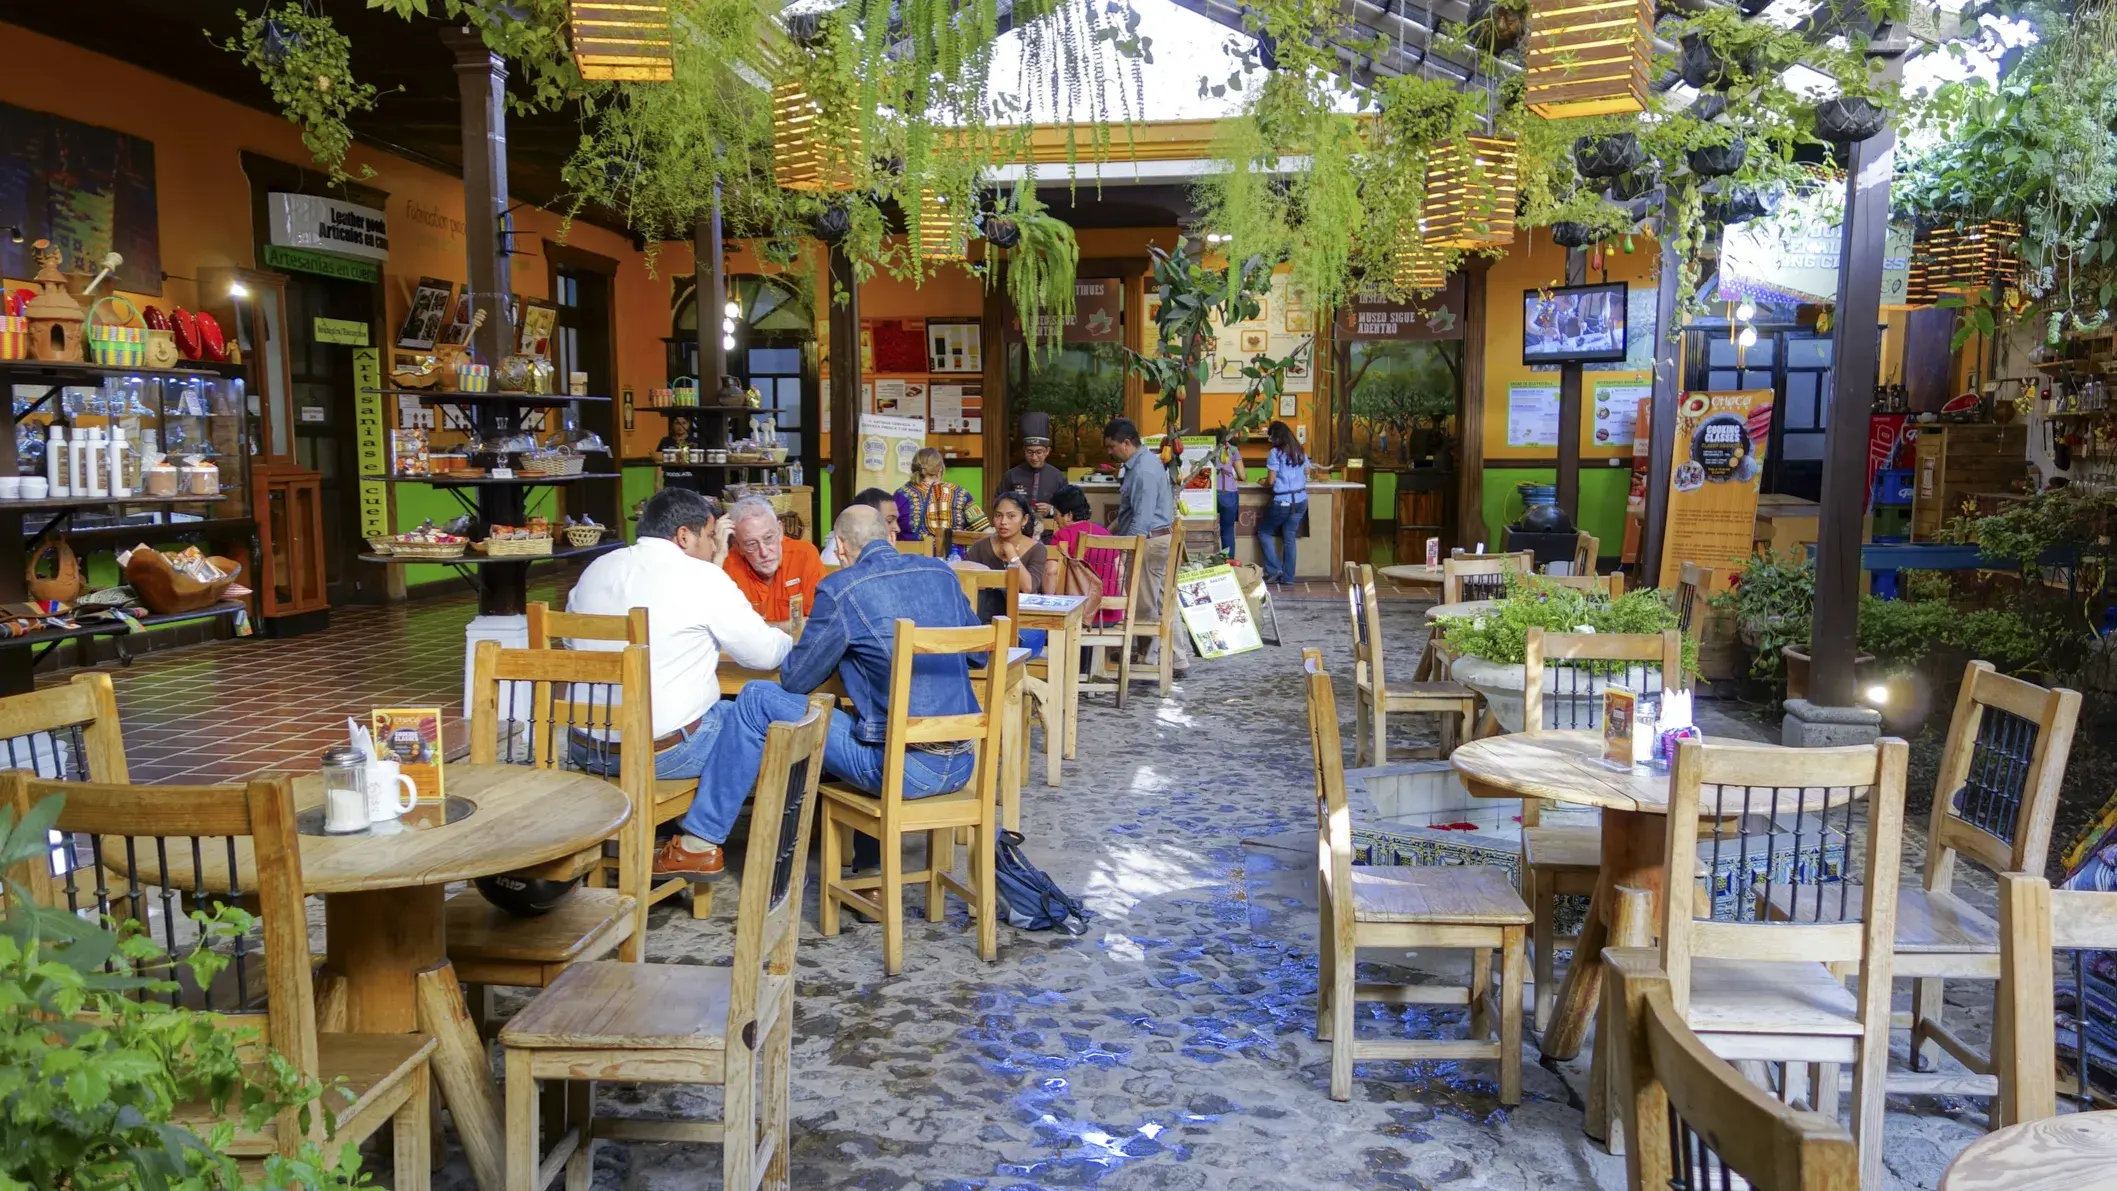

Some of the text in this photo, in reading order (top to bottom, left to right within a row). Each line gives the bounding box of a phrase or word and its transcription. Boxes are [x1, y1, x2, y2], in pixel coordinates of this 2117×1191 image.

[330, 207, 364, 229] Leather
[336, 264, 349, 277] en
[1074, 284, 1105, 296] TINUES
[1358, 311, 1416, 323] MUSEO SIGUE
[1357, 322, 1398, 334] ADENTRO
[1711, 395, 1752, 407] CHOCO
[1706, 424, 1740, 434] COOKING
[1704, 433, 1741, 443] CLASSES
